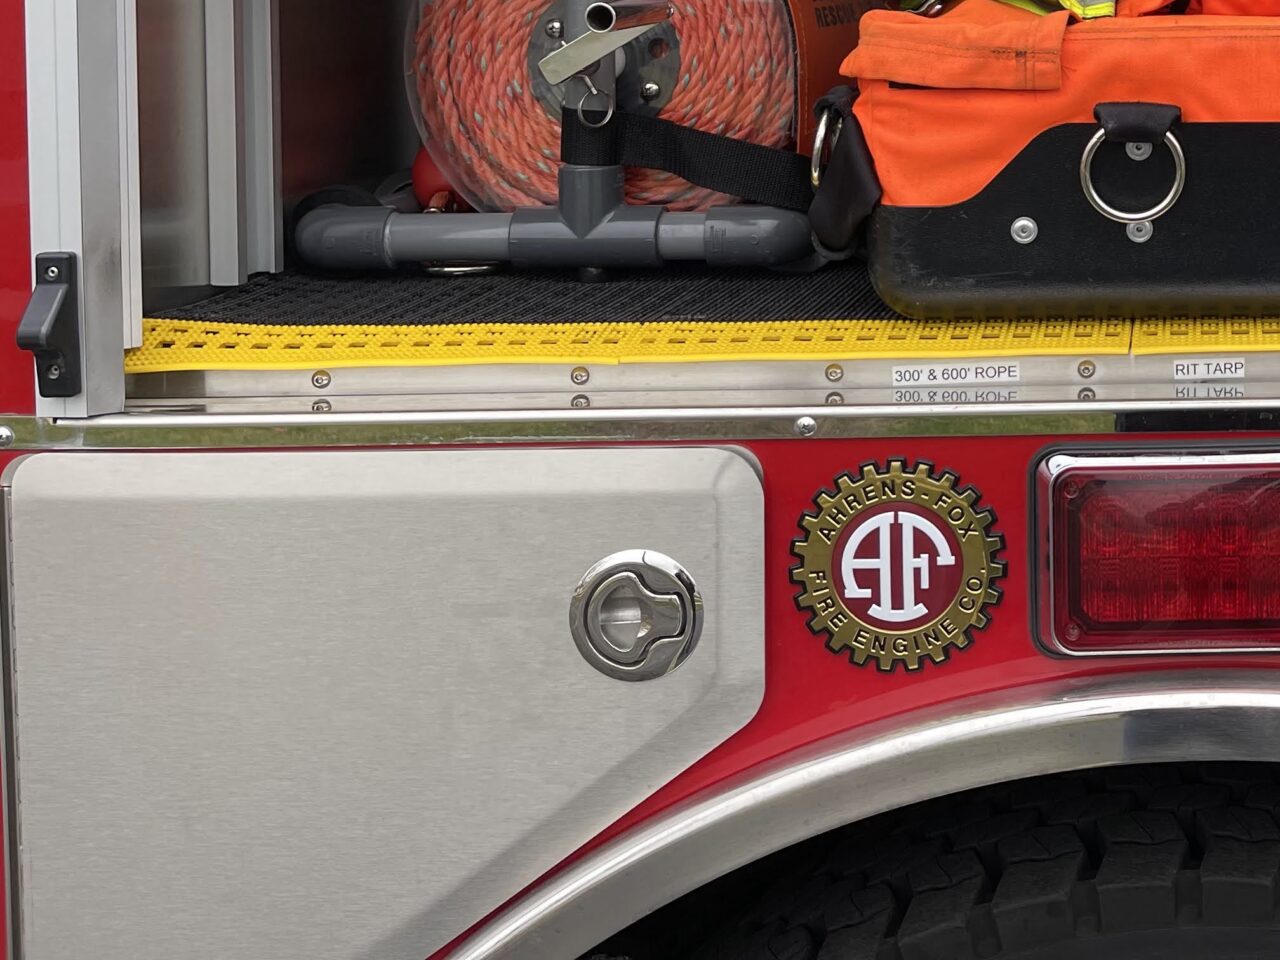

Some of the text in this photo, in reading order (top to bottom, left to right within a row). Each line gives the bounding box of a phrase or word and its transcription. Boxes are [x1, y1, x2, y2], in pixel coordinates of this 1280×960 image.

[895, 365, 1017, 382] 300' & 600' ROPE
[1175, 362, 1244, 376] RIT TARP
[817, 478, 979, 545] AHRENS-FOX
[808, 570, 848, 631] FIRE
[852, 618, 958, 655] ENGINE
